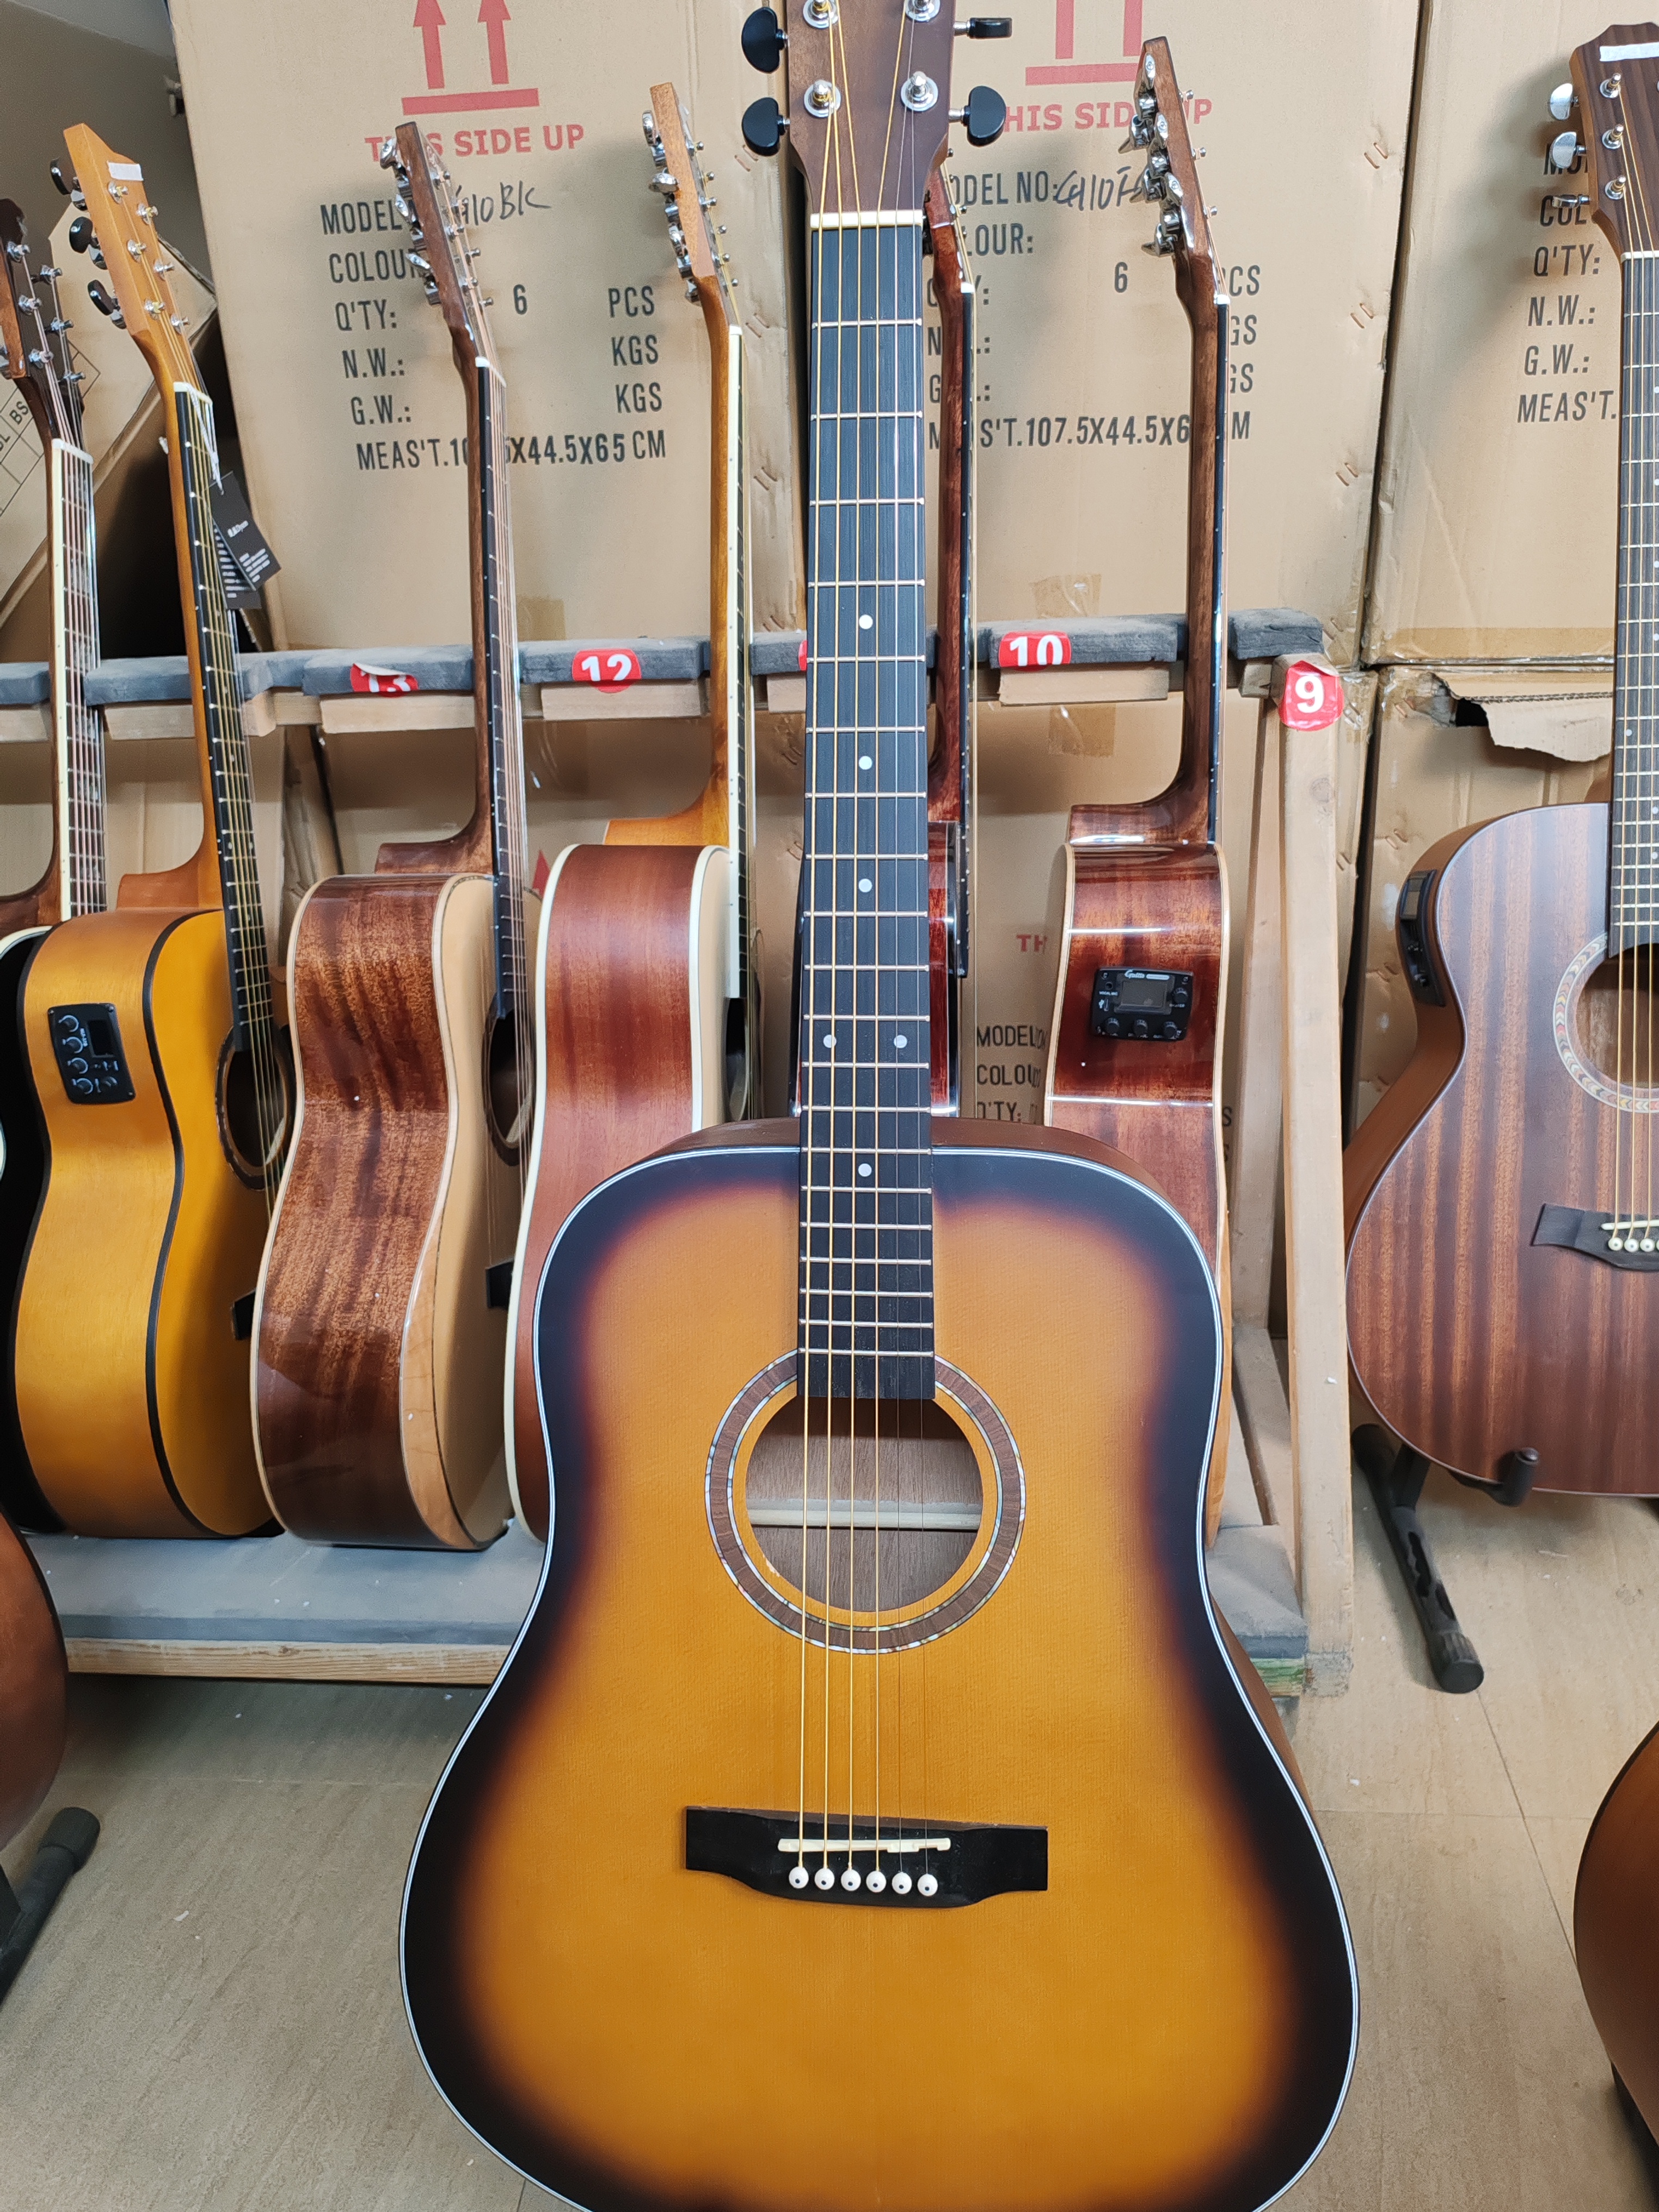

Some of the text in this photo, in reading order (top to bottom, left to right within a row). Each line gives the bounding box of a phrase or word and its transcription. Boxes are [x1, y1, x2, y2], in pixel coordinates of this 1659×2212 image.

[1003, 103, 1063, 133] HIS
[1074, 101, 1136, 129] SID
[454, 126, 532, 157] SIDE
[543, 124, 584, 151] UP
[949, 170, 1058, 206] ODEL NO:
[320, 200, 403, 235] MODEL
[1533, 243, 1600, 276] Q'TY:
[1114, 262, 1261, 297] 6 CS
[335, 284, 655, 331] Q'TY: 6 PCS
[1528, 294, 1595, 326] N.W.:
[342, 334, 659, 378] N.W.: KGS
[1523, 343, 1590, 376] G.W.:
[9, 401, 29, 425] BS
[350, 382, 662, 425] G.W.: KGS
[1517, 390, 1617, 423] MEAS'T.
[632, 430, 666, 459] CM
[1010, 634, 1063, 666] 10
[581, 654, 632, 681] 12
[1294, 674, 1324, 713] 9
